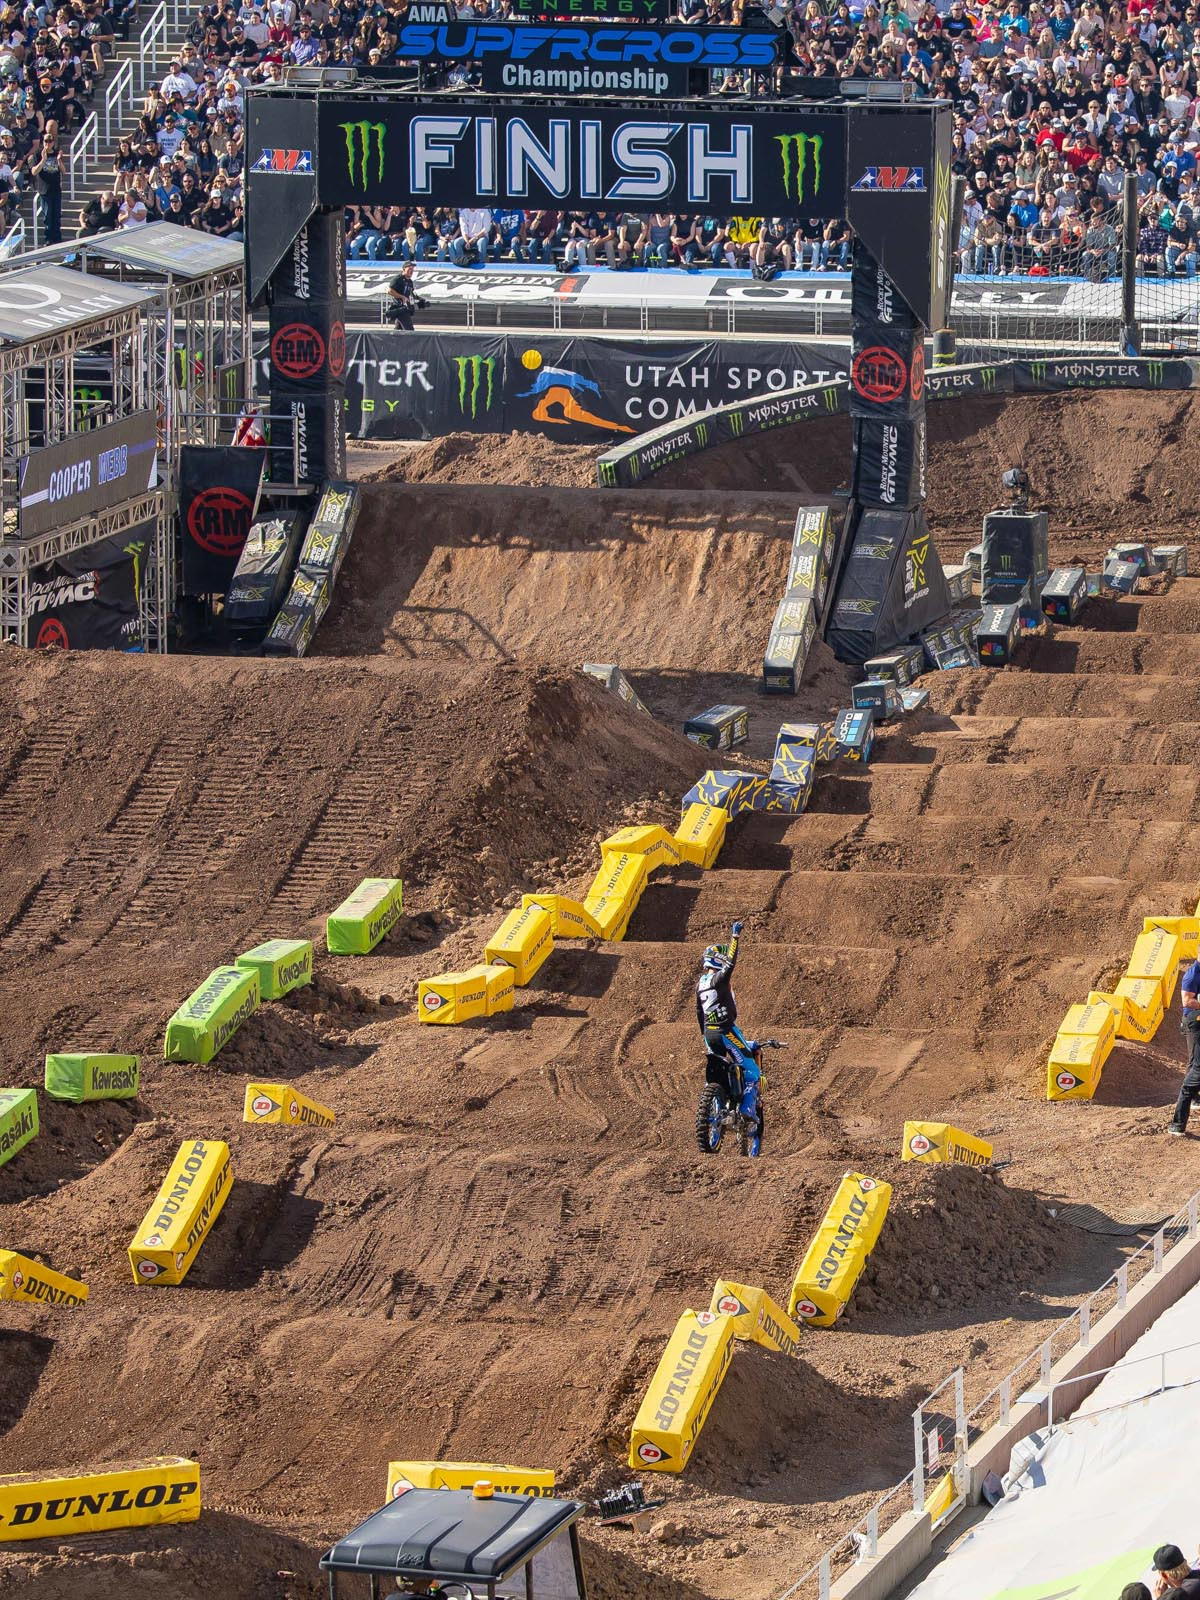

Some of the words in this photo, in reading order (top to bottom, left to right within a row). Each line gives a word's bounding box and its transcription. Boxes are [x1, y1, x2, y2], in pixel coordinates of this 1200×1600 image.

[408, 6, 447, 22] AMA
[519, 0, 657, 12] ENERGY
[396, 25, 780, 66] SUPERCROSS
[502, 64, 668, 94] Championship
[250, 149, 315, 171] AMA
[410, 116, 753, 204] FINISH
[851, 167, 927, 188] AMA
[346, 272, 395, 282] CKY
[414, 271, 562, 285] MOUNTAIN
[626, 366, 709, 388] UTAH
[728, 368, 848, 390] SPORTS
[924, 373, 974, 391] NSTER
[1055, 364, 1140, 377] MONSTER
[749, 395, 818, 422] MONSTER
[927, 390, 963, 399] ERGY
[760, 411, 810, 429] ENERGY
[641, 432, 692, 464] MONSTER
[882, 425, 890, 463] MOUNTAIN
[50, 459, 91, 502] COOPER
[98, 444, 128, 484] WEBB
[650, 450, 687, 471] ENERGY
[880, 464, 888, 491] ROCKY
[1054, 570, 1071, 594] peacock
[989, 607, 1005, 633] peacock
[836, 713, 853, 742] GoPro
[694, 806, 712, 835] DUNLOP
[607, 854, 629, 890] DUNLOP
[368, 899, 402, 944] Kawasaki
[507, 910, 531, 942] DUNLOP
[563, 911, 584, 925] DUNLOP
[528, 927, 551, 961] DUNLOP
[1145, 935, 1165, 975] DUNLOP
[278, 951, 310, 988] Kawasaki
[462, 991, 486, 1004] DUNLOP
[700, 988, 720, 1015] 2
[213, 984, 258, 1051] Kawasaki
[1128, 1016, 1147, 1034] DUNLOP
[726, 1032, 746, 1049] THOR
[92, 1062, 138, 1090] Kawasaki
[0, 1105, 34, 1153] asaki
[154, 1141, 209, 1232] DUNLOP
[187, 1162, 233, 1250] DUNLOP
[816, 1194, 867, 1290] DUNLOP
[24, 1277, 86, 1306] DUNLOP
[763, 1312, 798, 1357] DUNLOP
[657, 1329, 708, 1432] DUNLOP
[8, 1481, 198, 1526] DUNLOP
